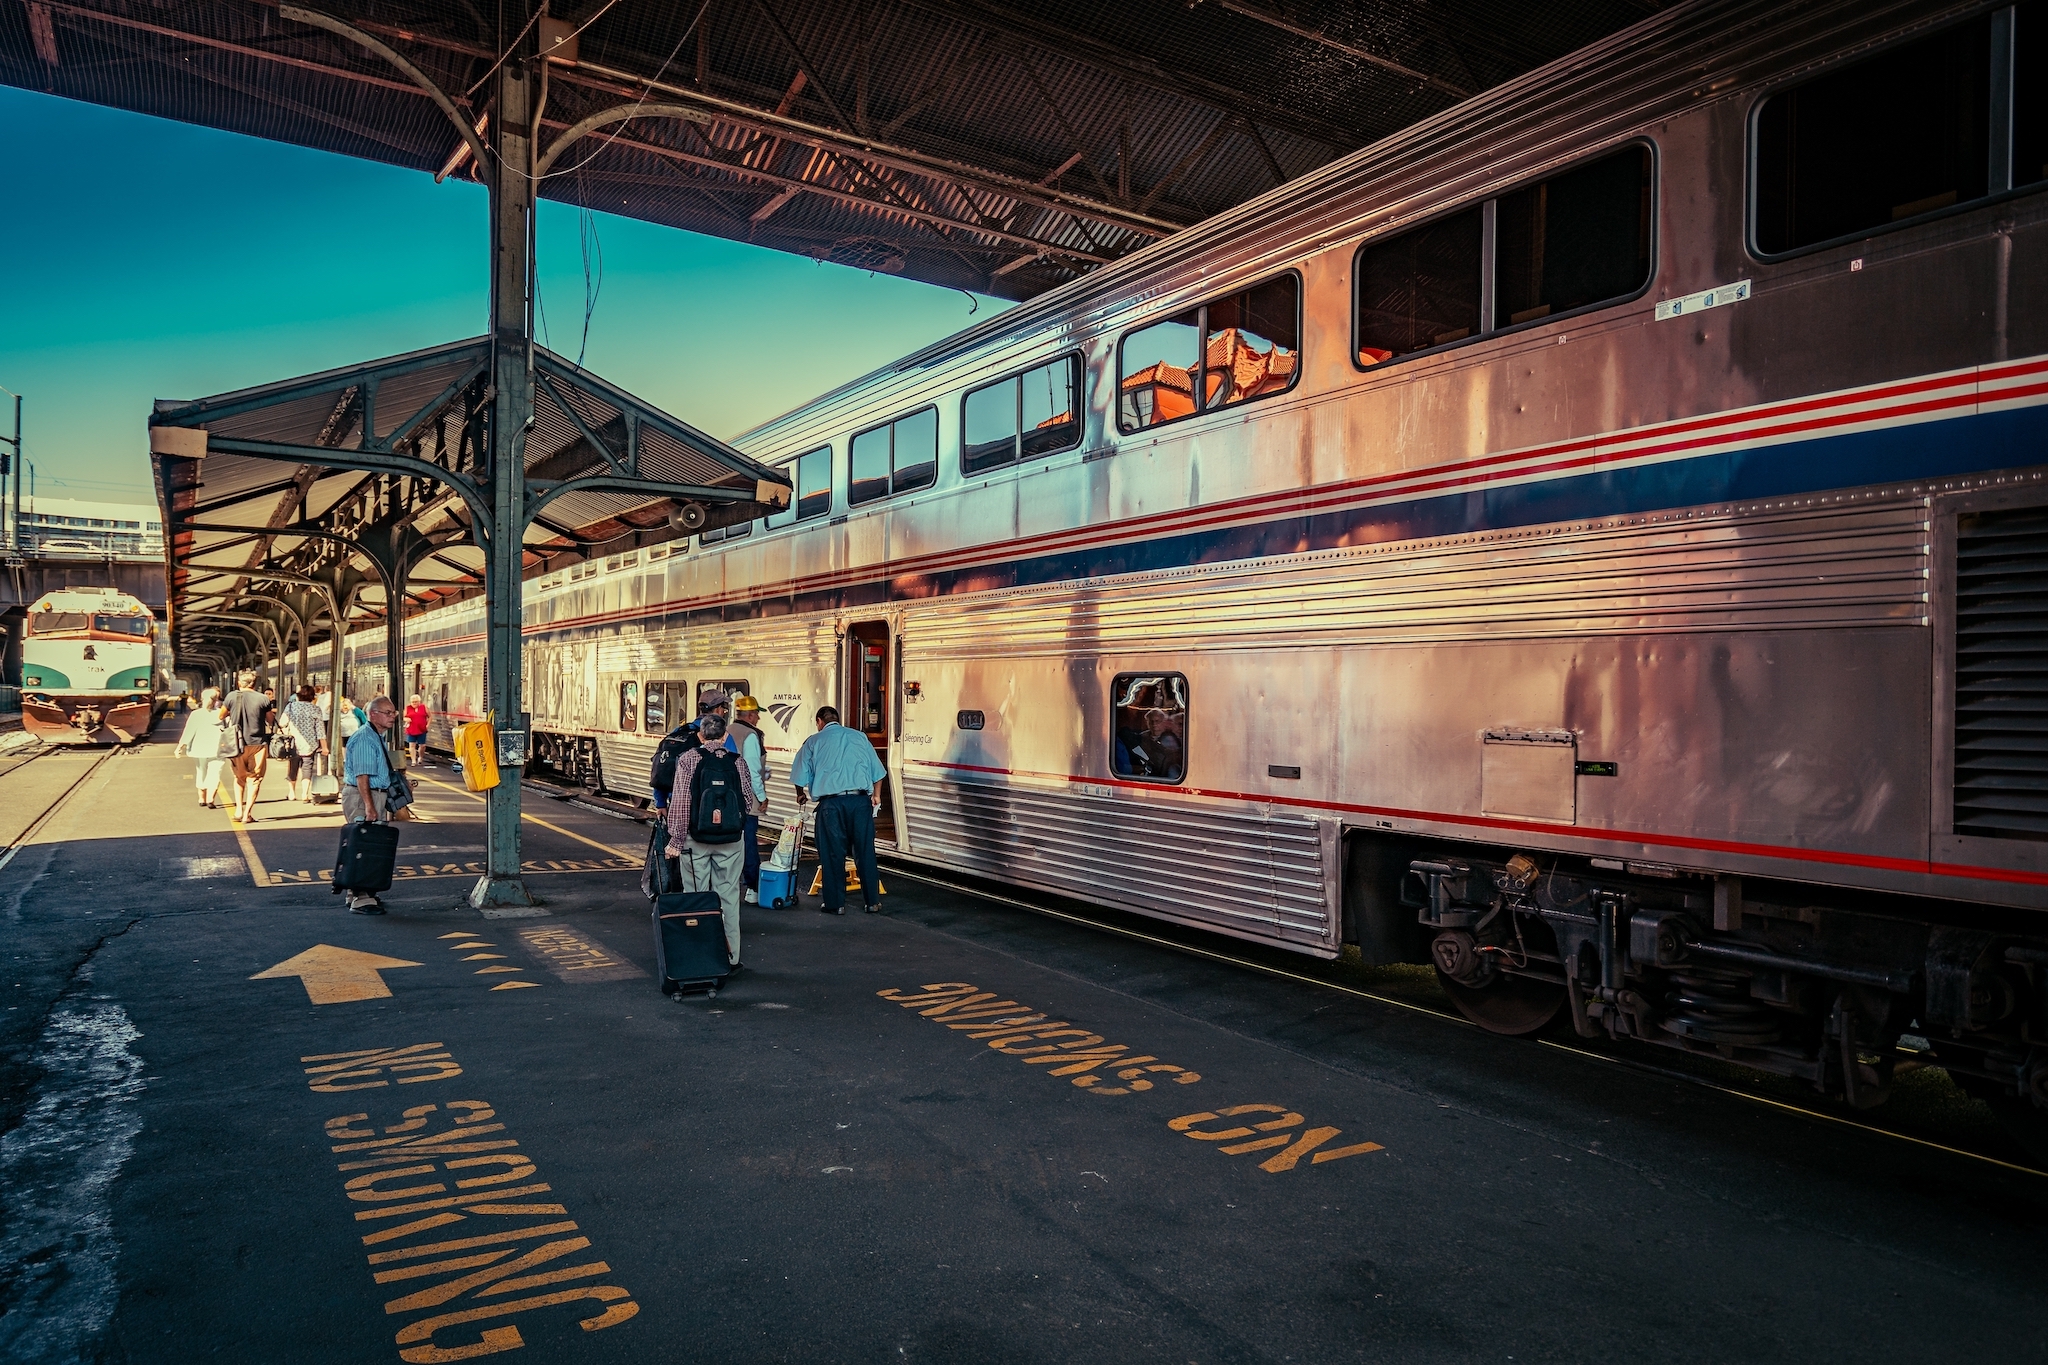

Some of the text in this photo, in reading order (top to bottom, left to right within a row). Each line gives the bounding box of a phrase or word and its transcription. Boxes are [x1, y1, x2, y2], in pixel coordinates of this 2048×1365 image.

[905, 731, 933, 746] Sleeping Car
[519, 929, 619, 971] NORTH
[876, 982, 1385, 1174] NO SMOKING
[301, 1042, 640, 1364] NO SMOKING
